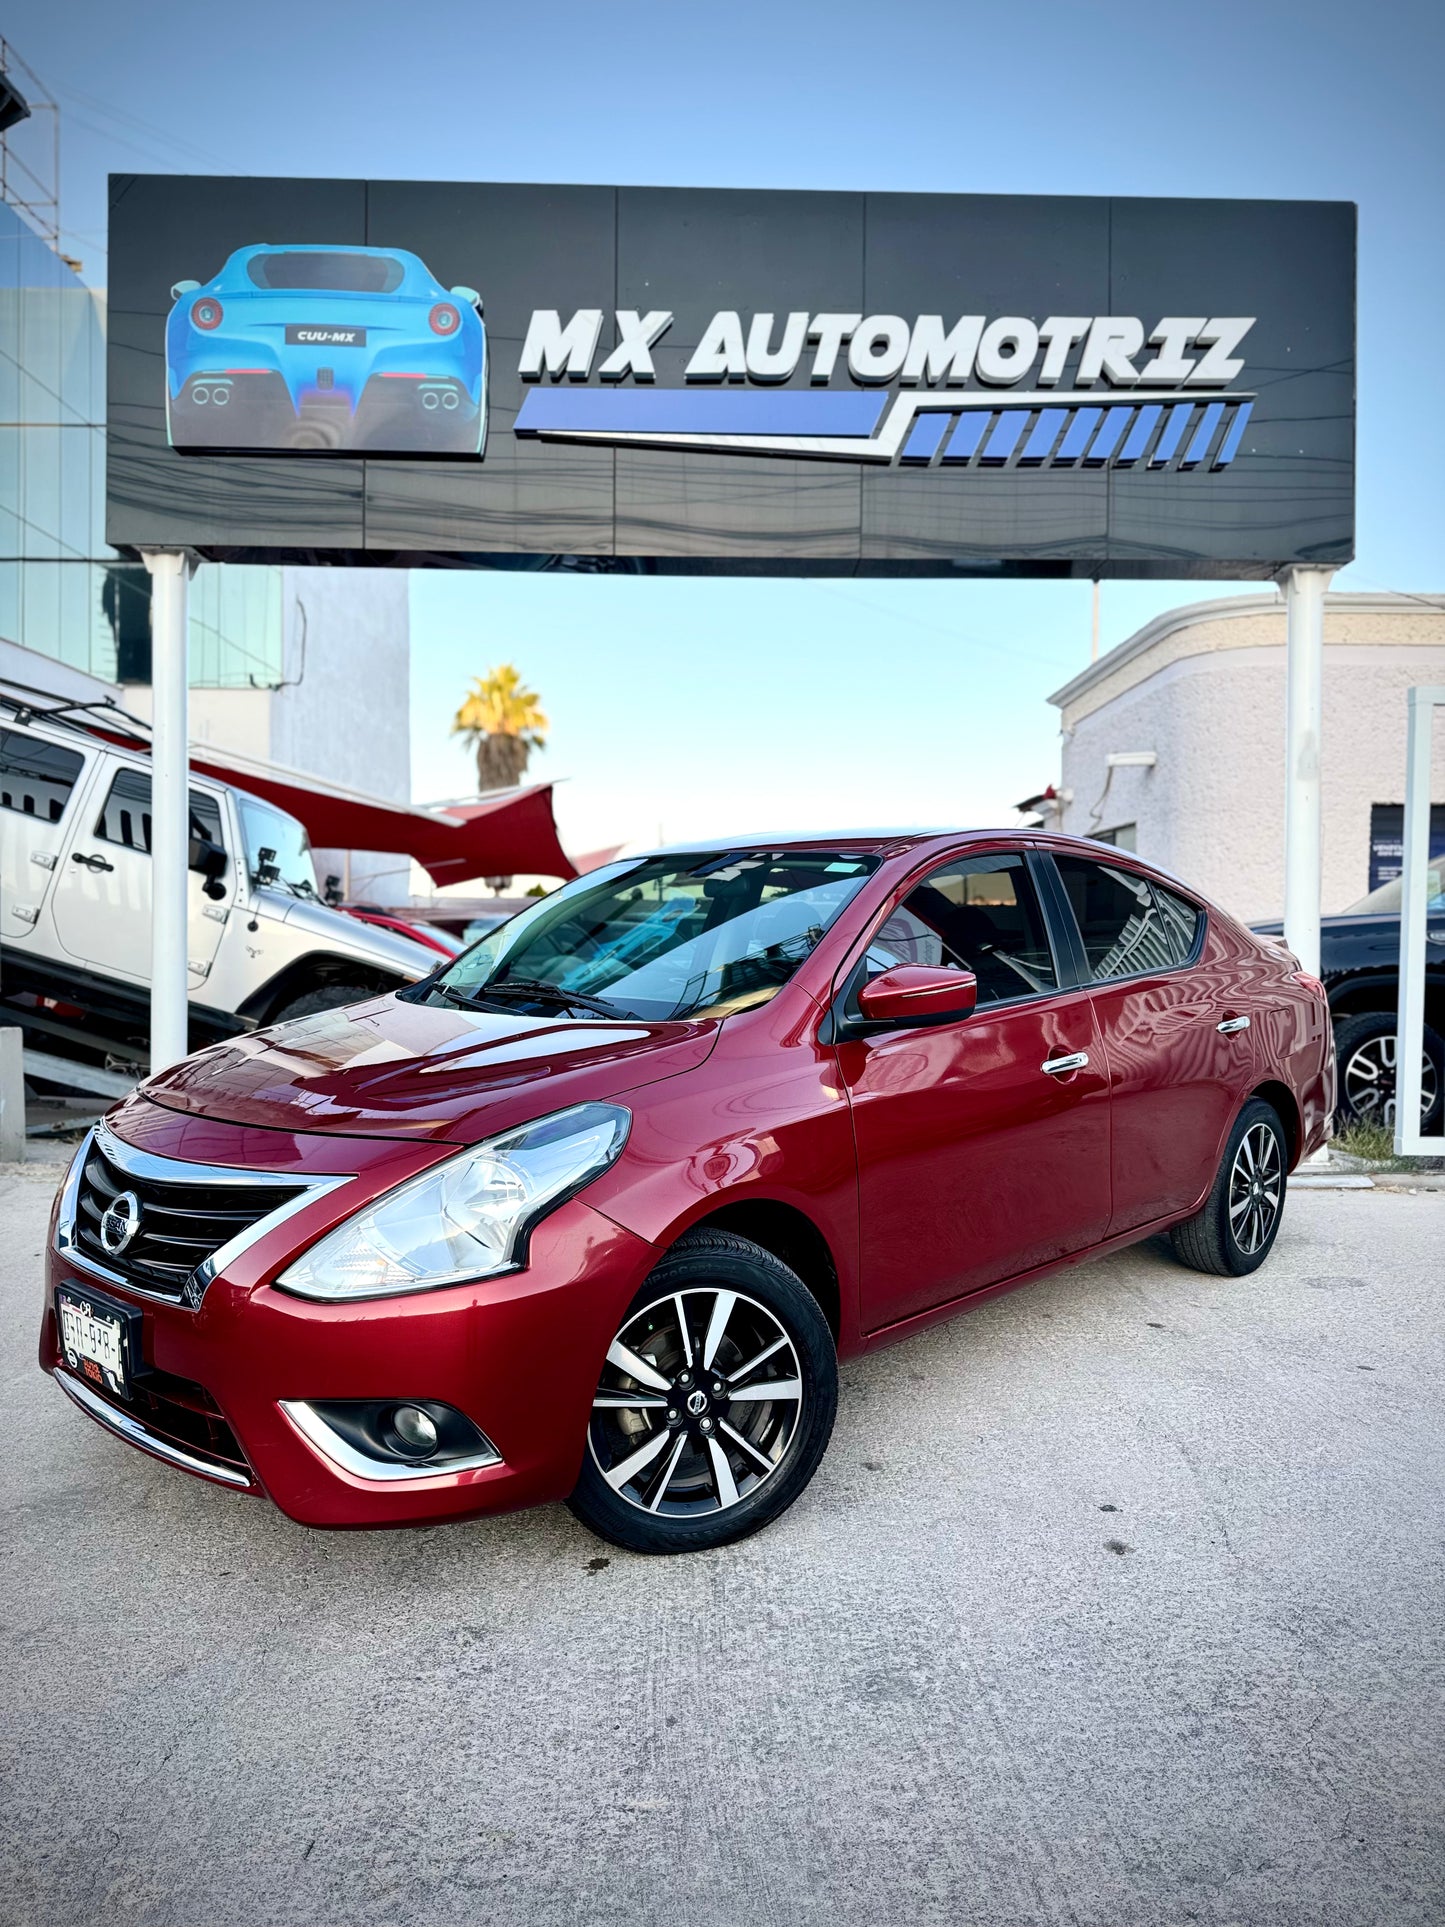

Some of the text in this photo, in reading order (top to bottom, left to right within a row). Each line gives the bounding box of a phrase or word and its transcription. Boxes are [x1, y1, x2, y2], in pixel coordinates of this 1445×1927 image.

[297, 330, 356, 343] CUU-MX
[518, 309, 1257, 387] MX AUTOMOTRIZ
[105, 1212, 128, 1235] SSAN
